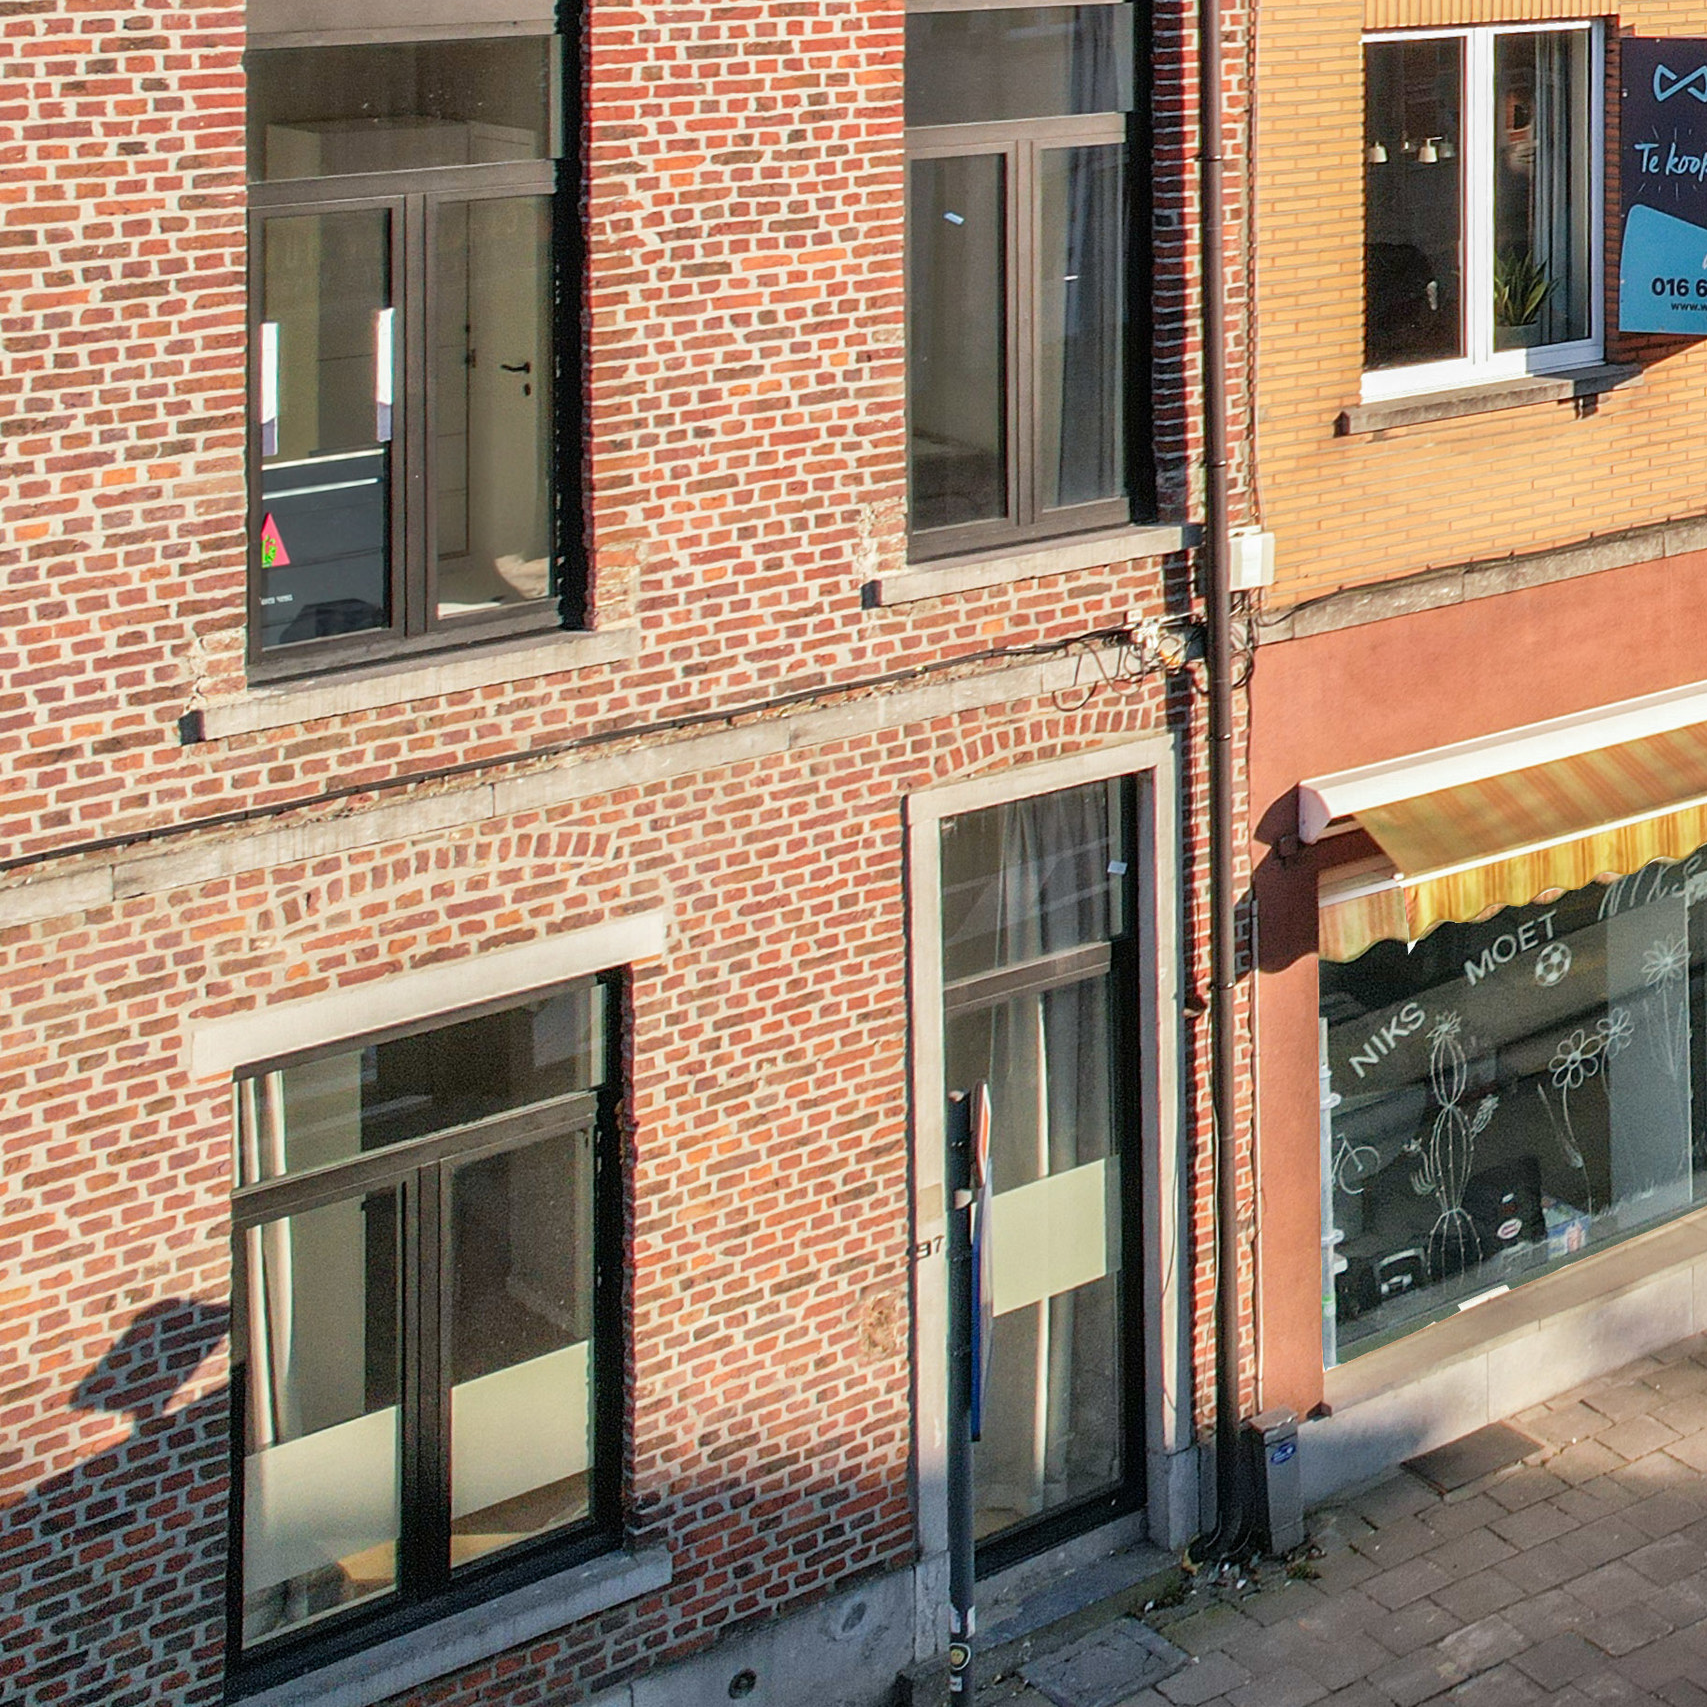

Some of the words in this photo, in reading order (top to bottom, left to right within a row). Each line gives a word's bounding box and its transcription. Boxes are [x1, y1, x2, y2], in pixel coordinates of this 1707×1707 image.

[1634, 143, 1659, 173] Te
[1651, 277, 1690, 297] 016
[1348, 1001, 1426, 1079] NIKS
[1463, 909, 1557, 986] MOET
